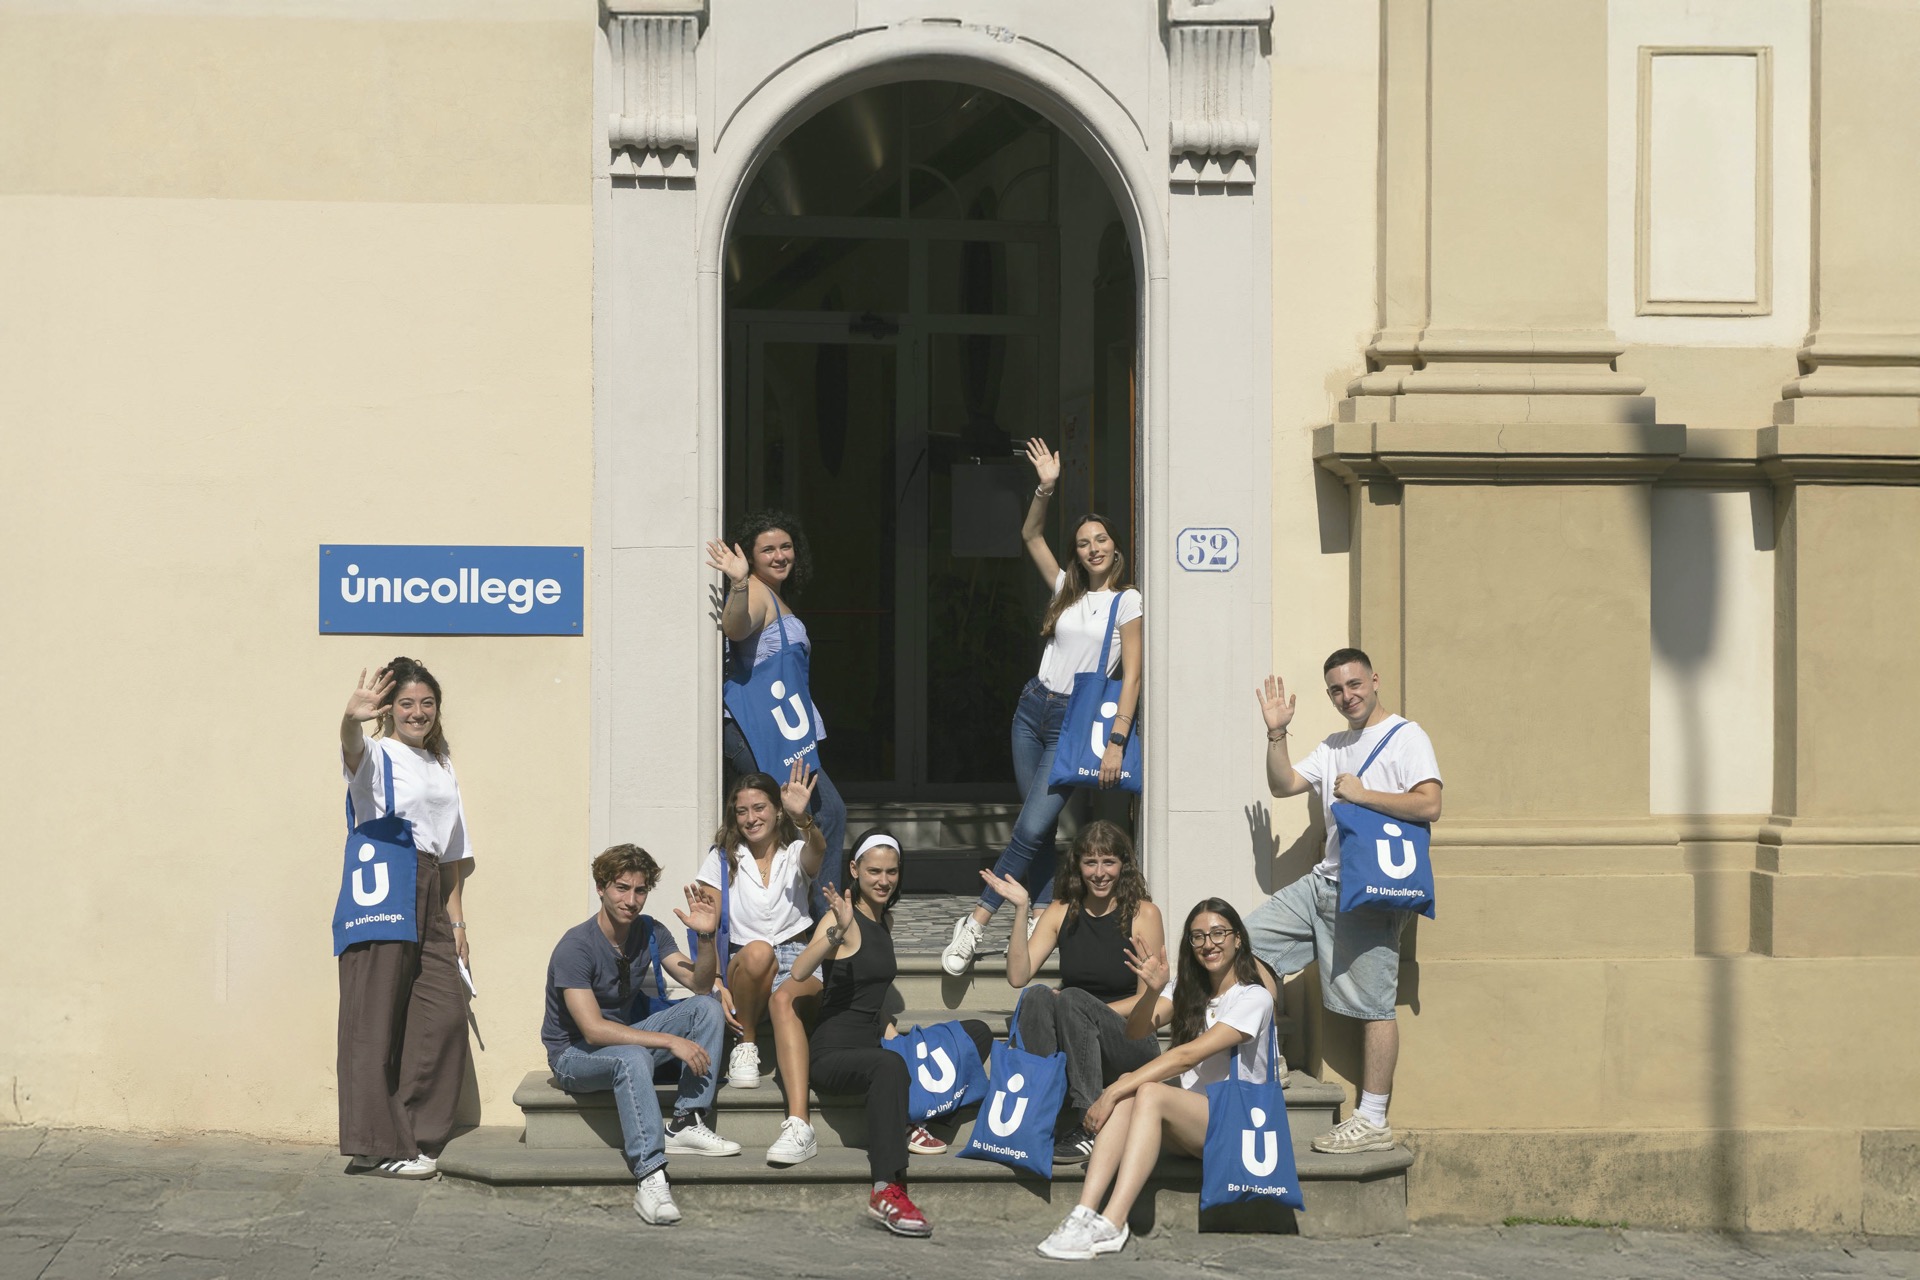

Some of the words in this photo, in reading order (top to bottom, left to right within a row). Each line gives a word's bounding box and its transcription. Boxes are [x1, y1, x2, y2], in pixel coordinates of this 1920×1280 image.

[1187, 533, 1228, 565] 52
[783, 758, 795, 767] Be
[793, 740, 817, 760] Unicol
[1078, 767, 1090, 776] Be
[1366, 885, 1378, 894] Be
[1379, 886, 1426, 898] Unicollege.
[355, 913, 405, 926] Unicollege.
[972, 1139, 982, 1149] Be
[982, 1142, 1029, 1159] Unicollege.
[1227, 1183, 1241, 1192] Be
[1241, 1184, 1289, 1196] Unicollege.
